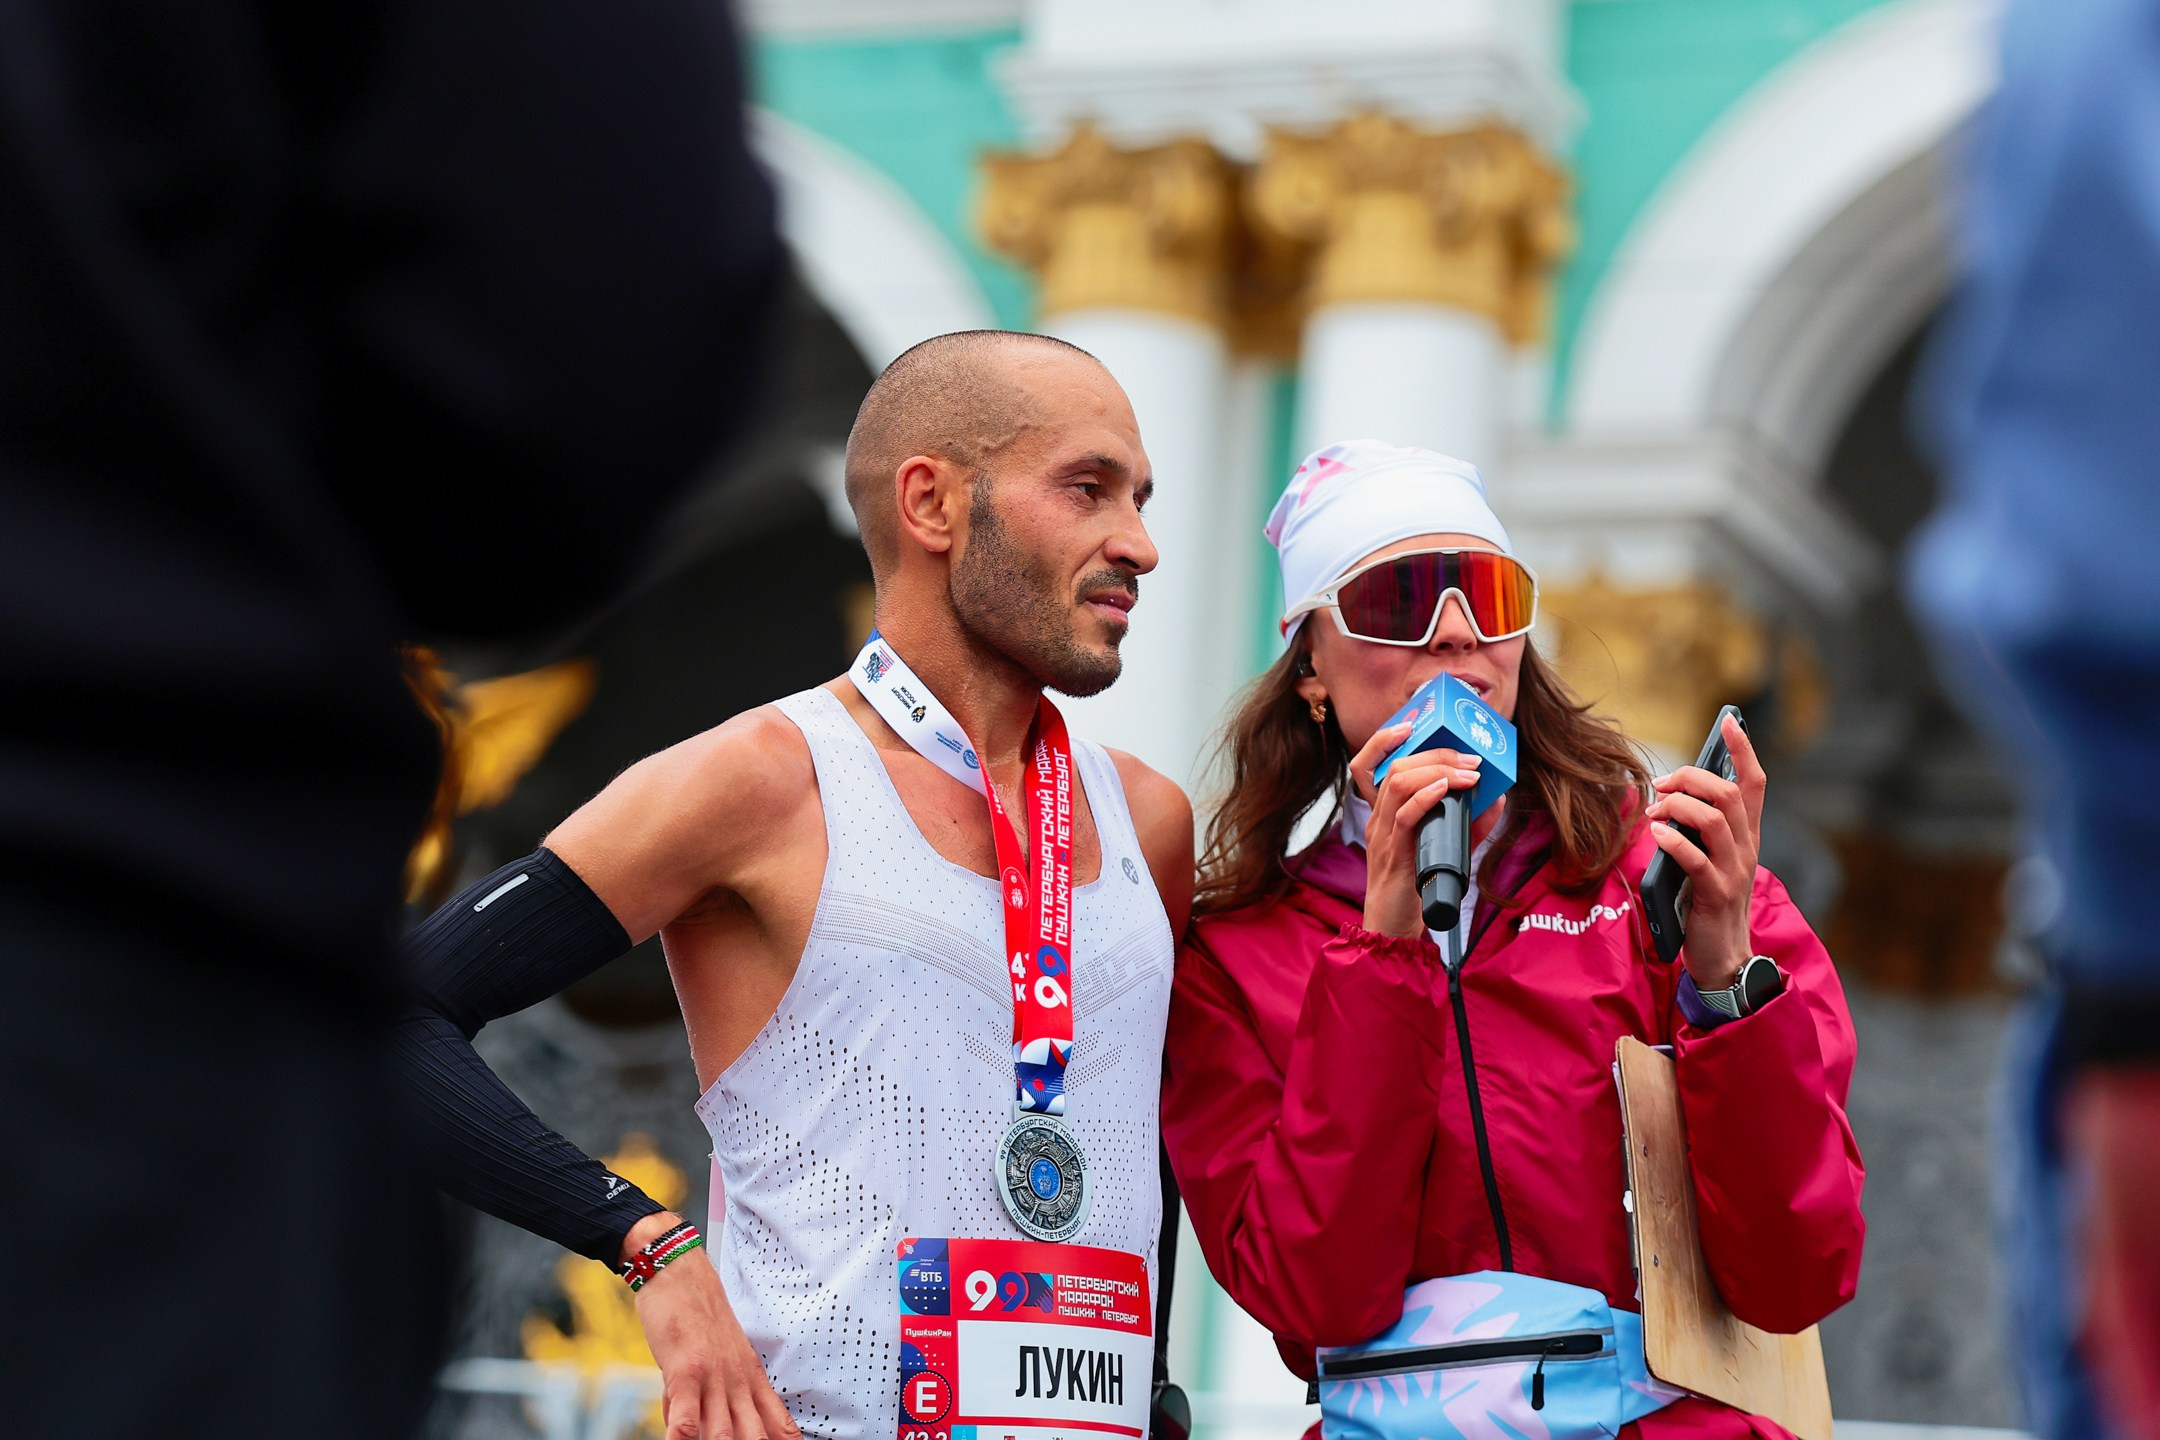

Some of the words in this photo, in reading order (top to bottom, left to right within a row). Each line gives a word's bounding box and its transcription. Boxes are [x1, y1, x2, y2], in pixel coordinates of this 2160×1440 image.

[1053, 747, 1070, 848] ПЕТЕРБУРГ
[1036, 789, 1054, 941] ПЕТЕРБУРГСКИЙ
[1055, 864, 1069, 946] ПУШКИН
[1011, 952, 1029, 978] 4
[1035, 944, 1068, 1008] 99
[1000, 1149, 1006, 1160] 99
[1005, 1119, 1059, 1149] ПЕТЕРБУРГСКИЙ
[1059, 1127, 1087, 1171] МАРАФОН
[605, 1182, 632, 1200] DEMIX
[920, 1272, 942, 1283] ВТБ
[965, 1270, 1027, 1311] 99
[1057, 1274, 1139, 1298] ПЕТЕРБУРГСКИЙ
[1057, 1289, 1114, 1308] МАРАФОН
[1058, 1305, 1096, 1319] ПУШКИН
[1101, 1311, 1139, 1325] ПЕТЕРБУРГ
[1015, 1345, 1124, 1406] ЛУКИН
